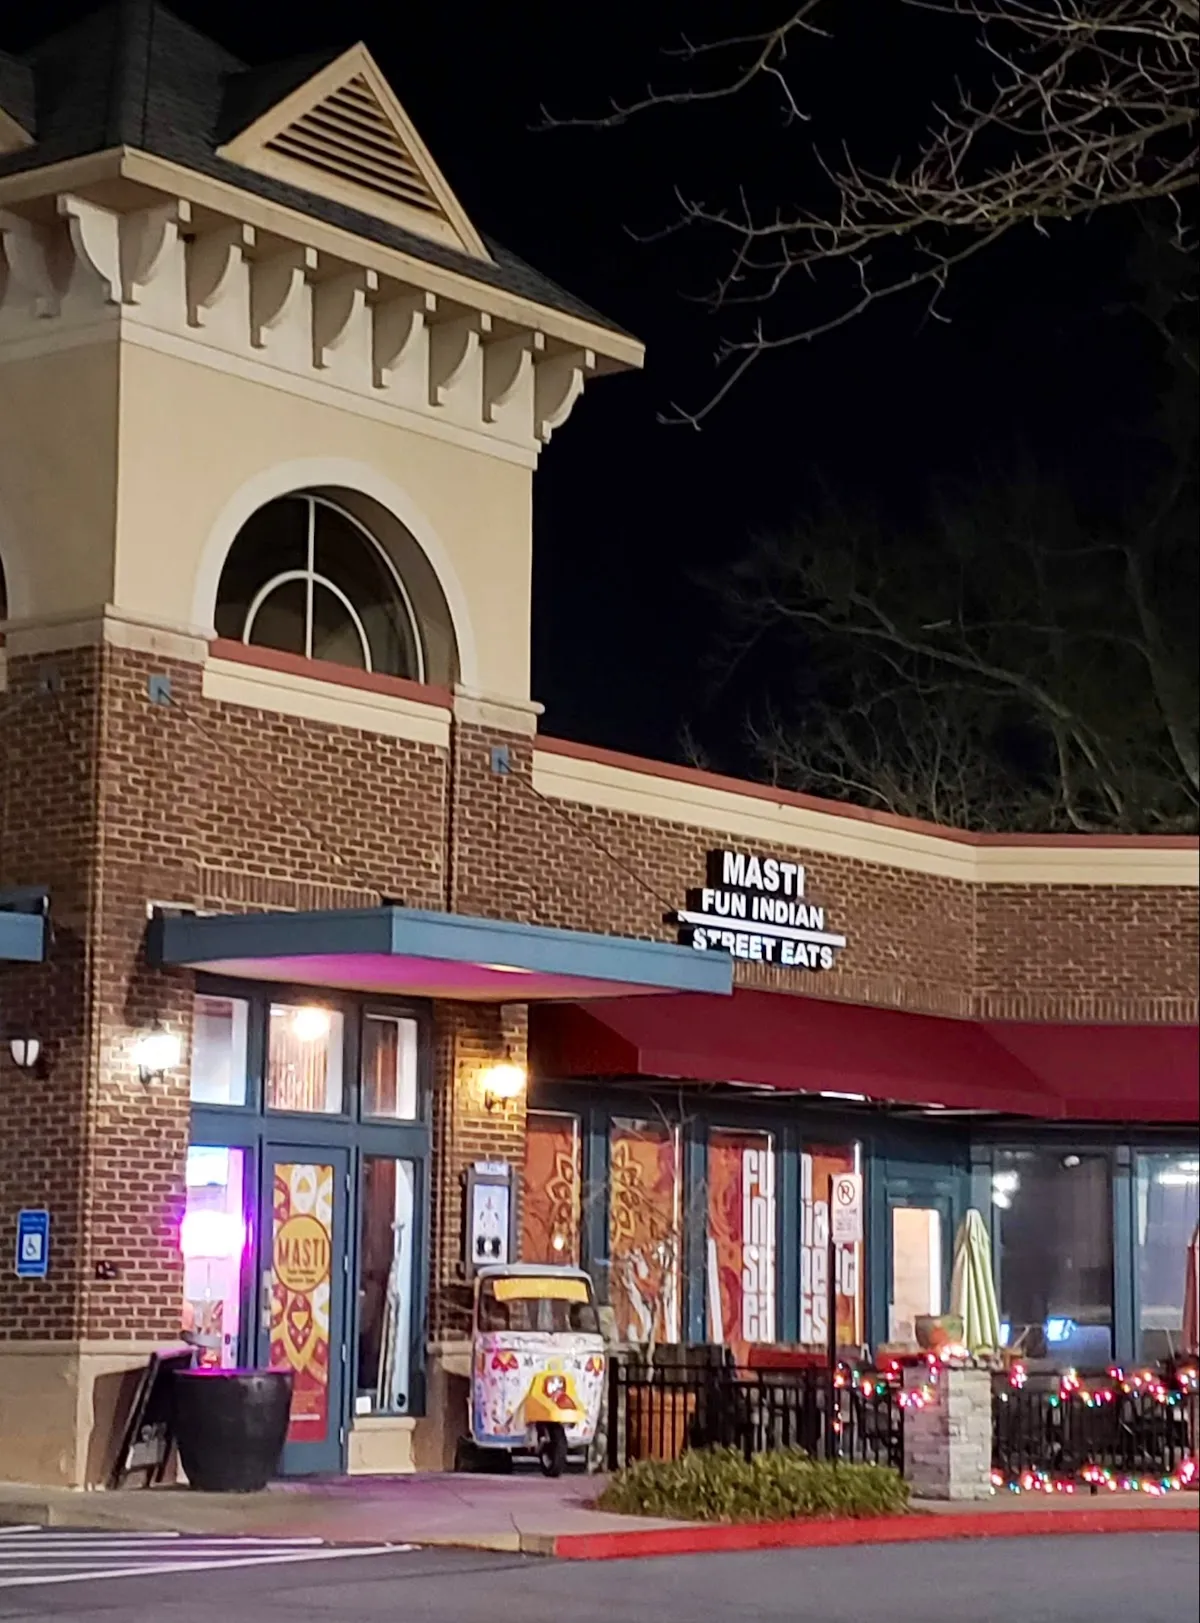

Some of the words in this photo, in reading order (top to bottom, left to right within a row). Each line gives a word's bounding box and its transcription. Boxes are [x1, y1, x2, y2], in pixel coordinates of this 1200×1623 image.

[722, 850, 806, 897] MASTI
[701, 887, 747, 918] FUN
[751, 896, 825, 931] INDIAN
[692, 927, 777, 961] STREET
[780, 939, 834, 970] EATS
[278, 1237, 326, 1268] MASTI
